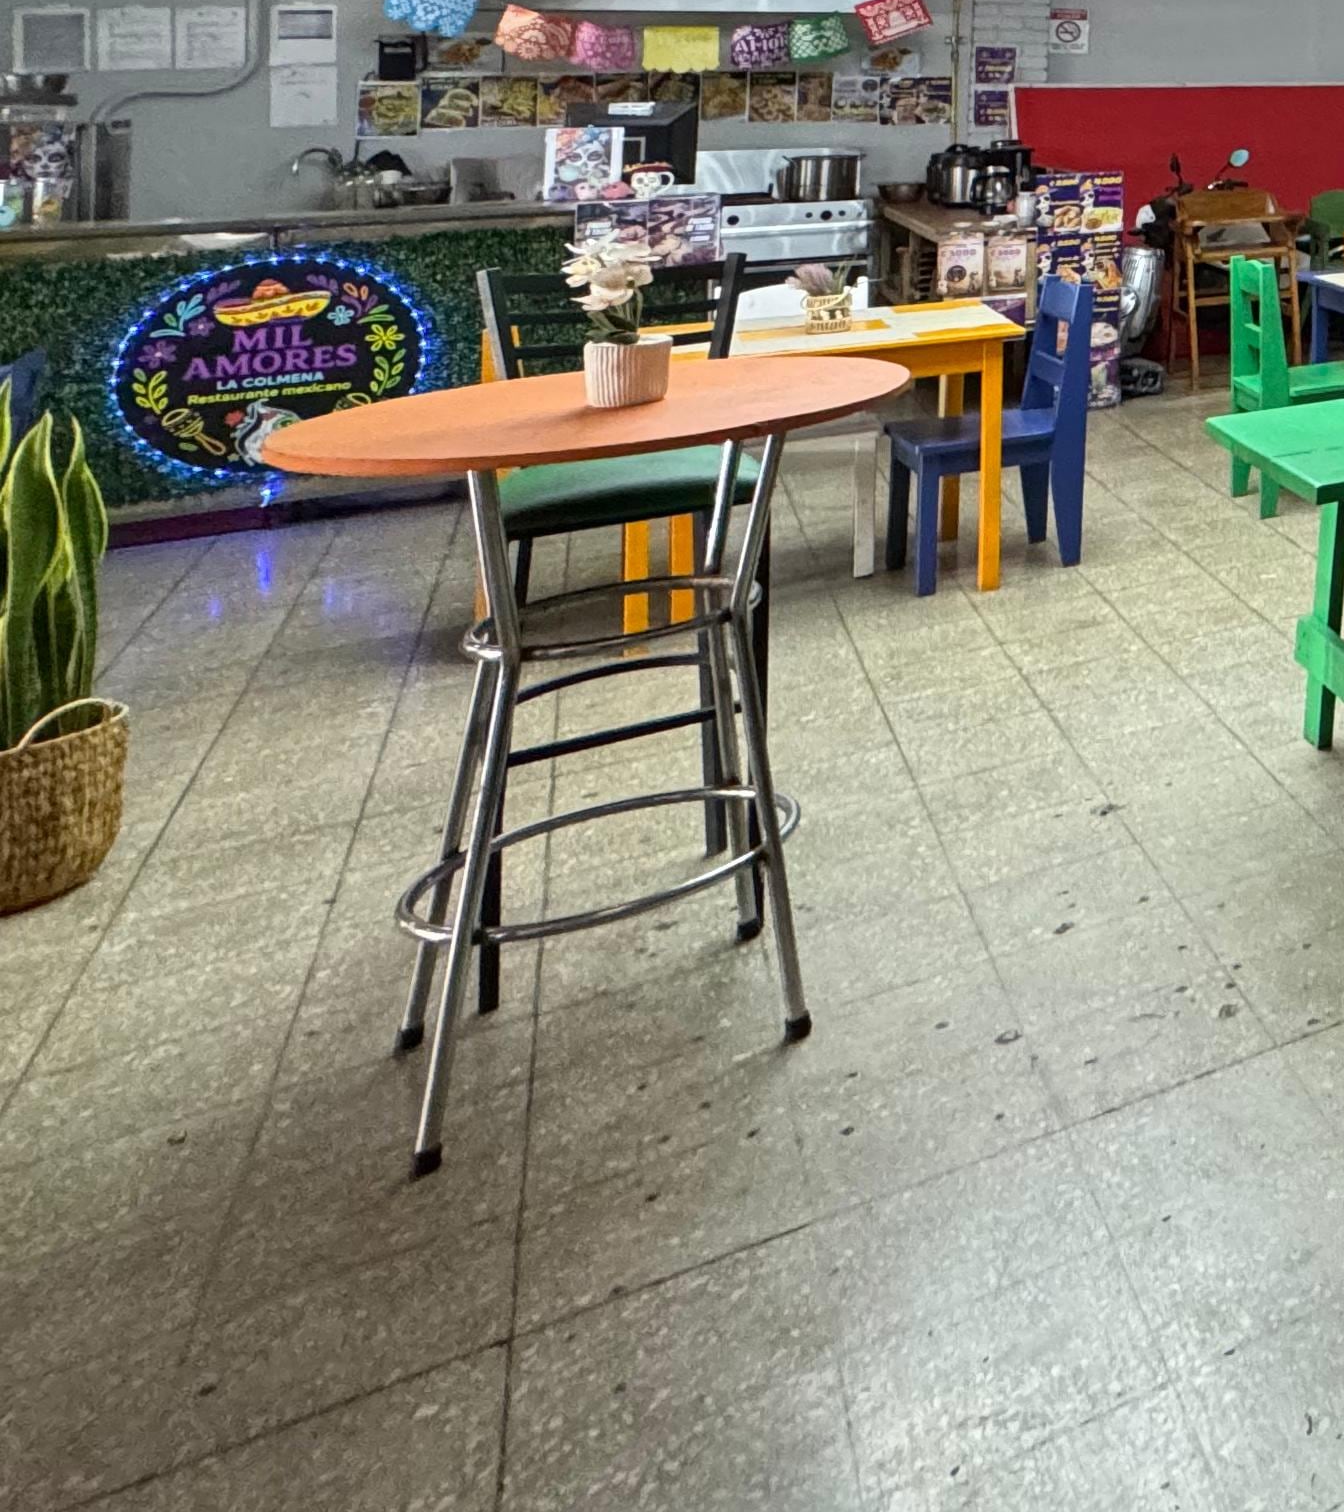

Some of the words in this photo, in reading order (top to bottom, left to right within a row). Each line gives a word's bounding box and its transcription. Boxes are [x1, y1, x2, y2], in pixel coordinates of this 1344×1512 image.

[231, 325, 313, 353] MIL
[182, 343, 358, 381] AMORES
[187, 388, 279, 406] Restaurante
[281, 381, 352, 395] mexicano
[216, 380, 238, 391] LA
[242, 371, 325, 389] COLMENA
